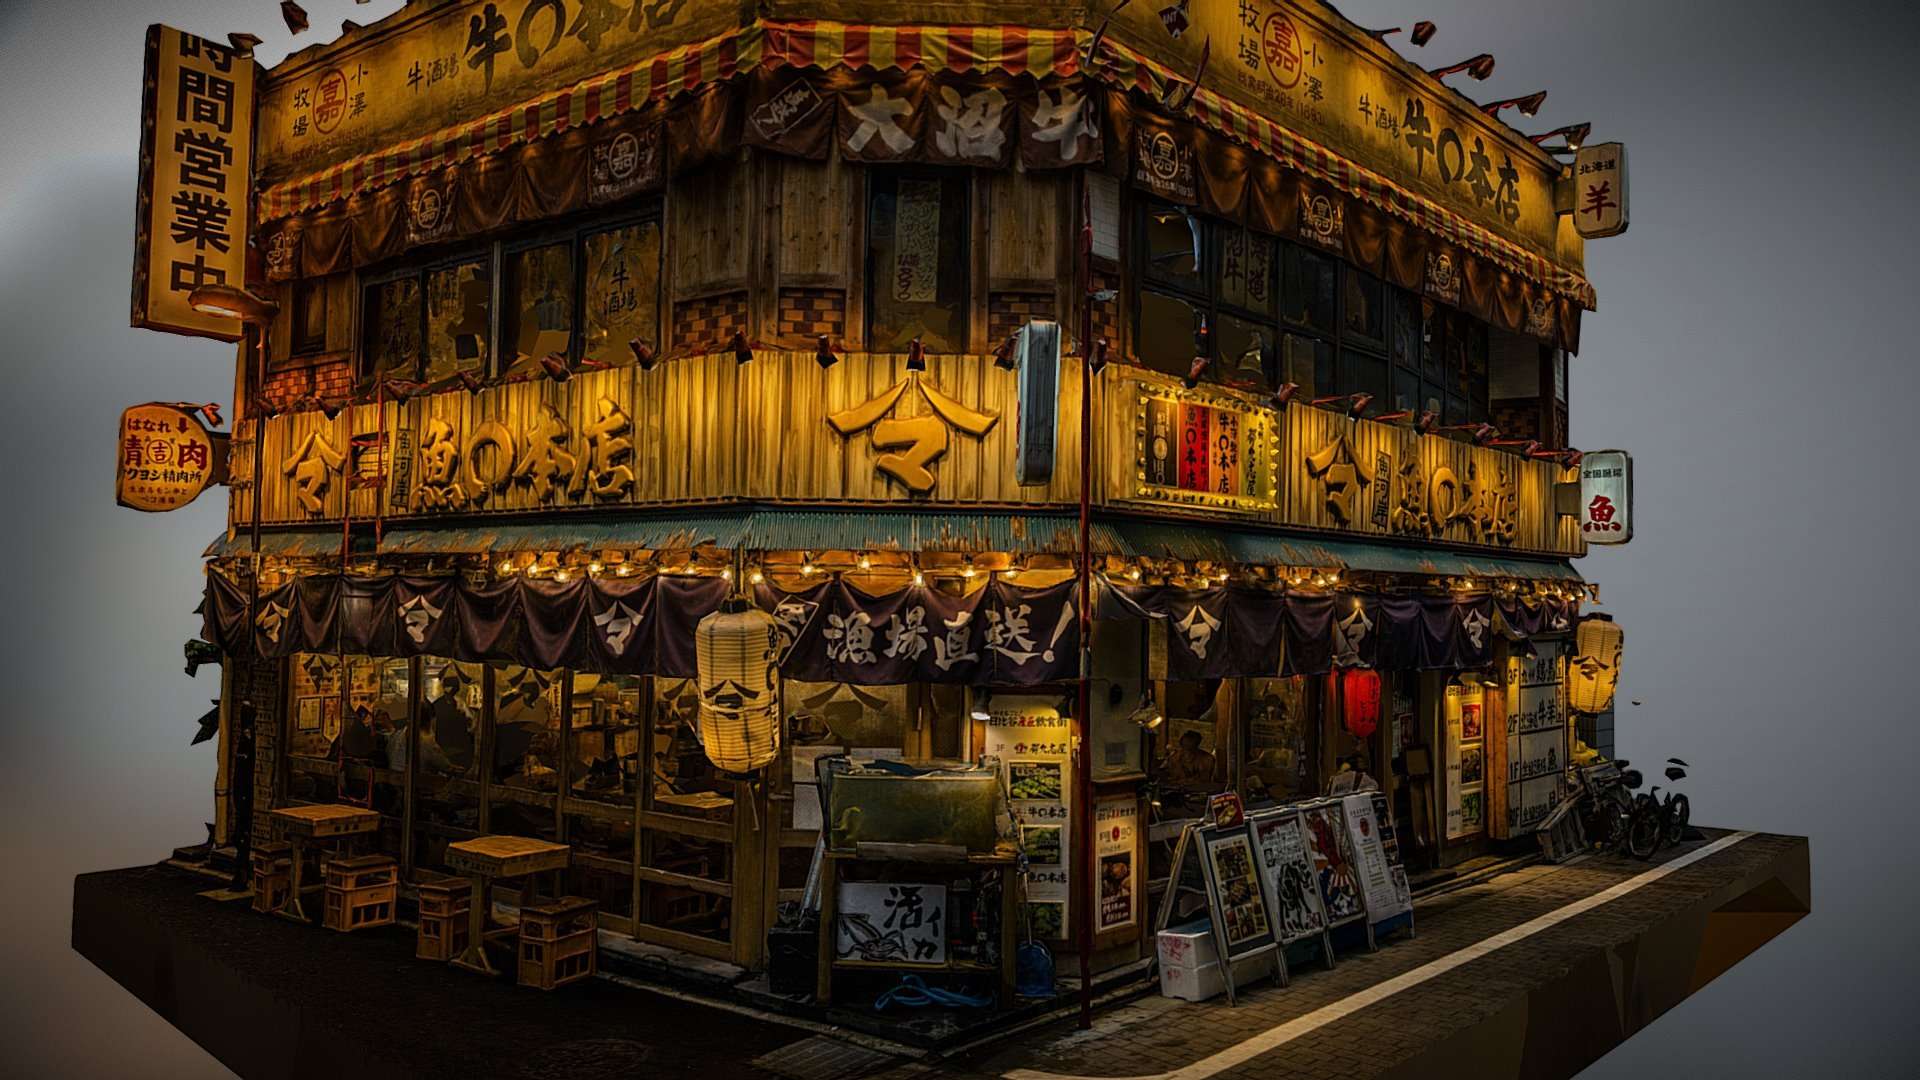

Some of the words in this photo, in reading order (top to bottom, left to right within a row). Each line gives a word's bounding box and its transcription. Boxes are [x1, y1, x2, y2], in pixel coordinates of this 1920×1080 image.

[1265, 19, 1299, 73] 嘉
[315, 78, 344, 125] 嘉
[171, 31, 237, 290] 時間営業中
[1579, 158, 1617, 175] 北海道
[1580, 180, 1617, 221] 羊
[611, 261, 629, 292] 牛
[127, 418, 172, 433] はなれ
[177, 439, 209, 471] 肉
[1583, 495, 1621, 532] 魚
